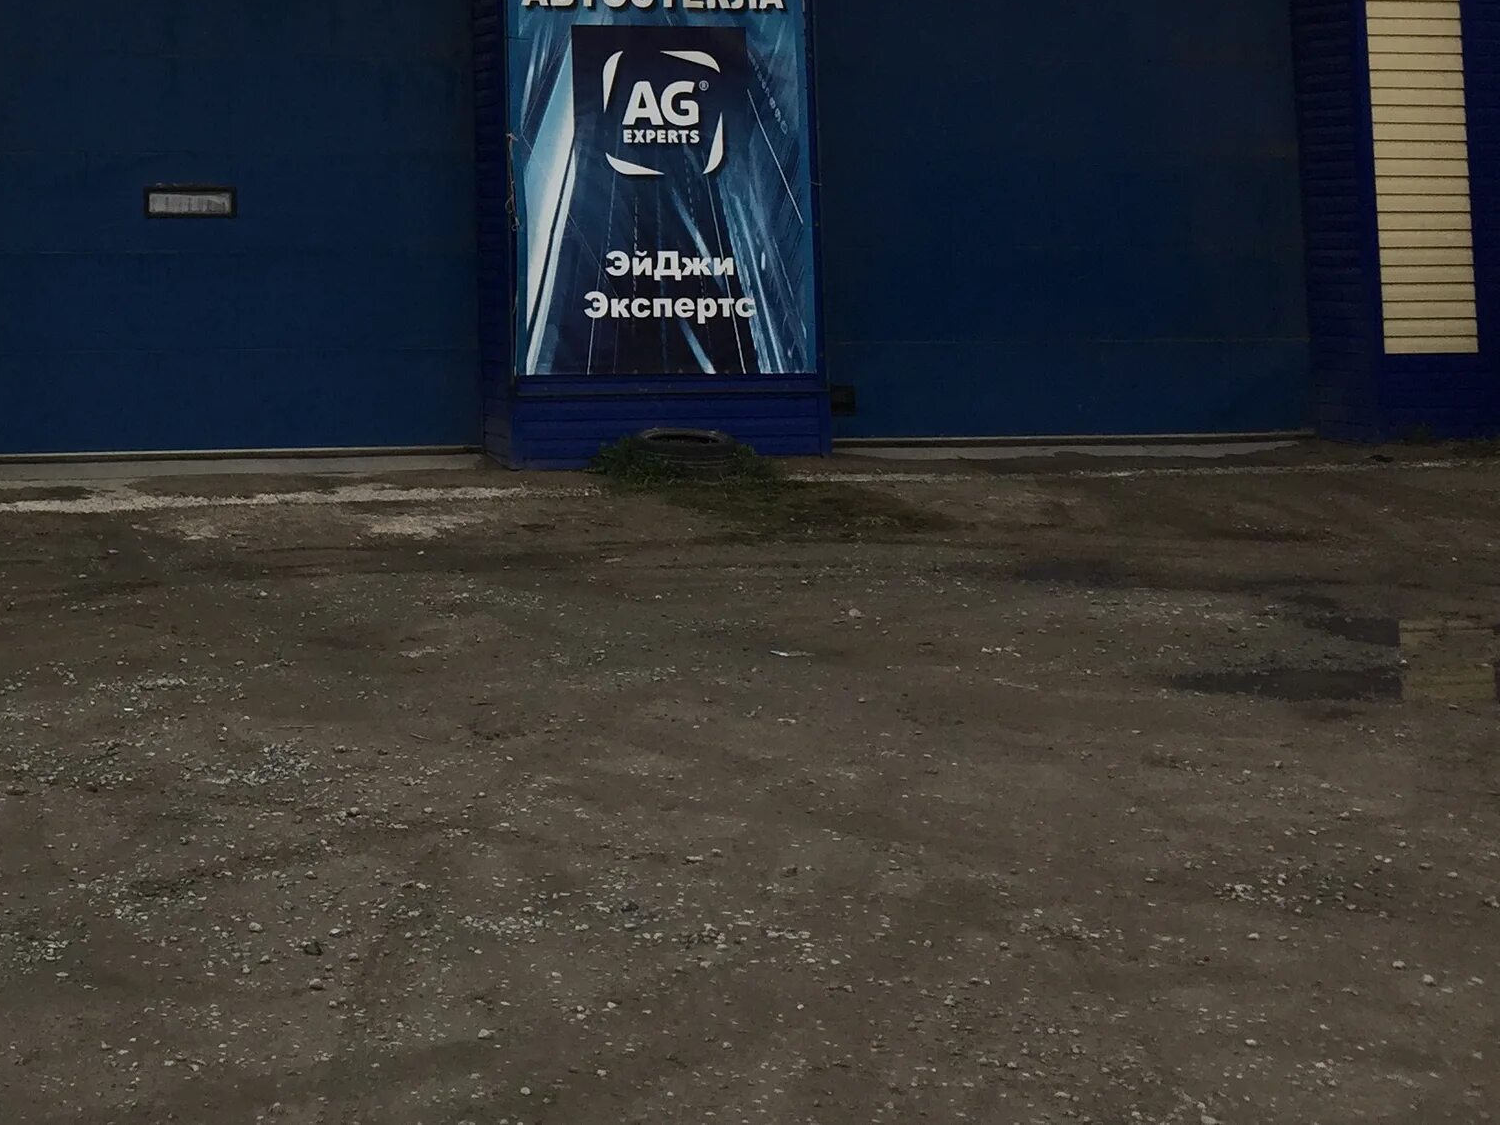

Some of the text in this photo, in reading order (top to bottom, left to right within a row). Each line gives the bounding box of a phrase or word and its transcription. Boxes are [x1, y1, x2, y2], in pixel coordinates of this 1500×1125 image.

[622, 81, 699, 125] AG
[623, 129, 700, 144] EXPERTS
[606, 251, 734, 281] ЭйДжи
[583, 291, 757, 324] Экспертс
